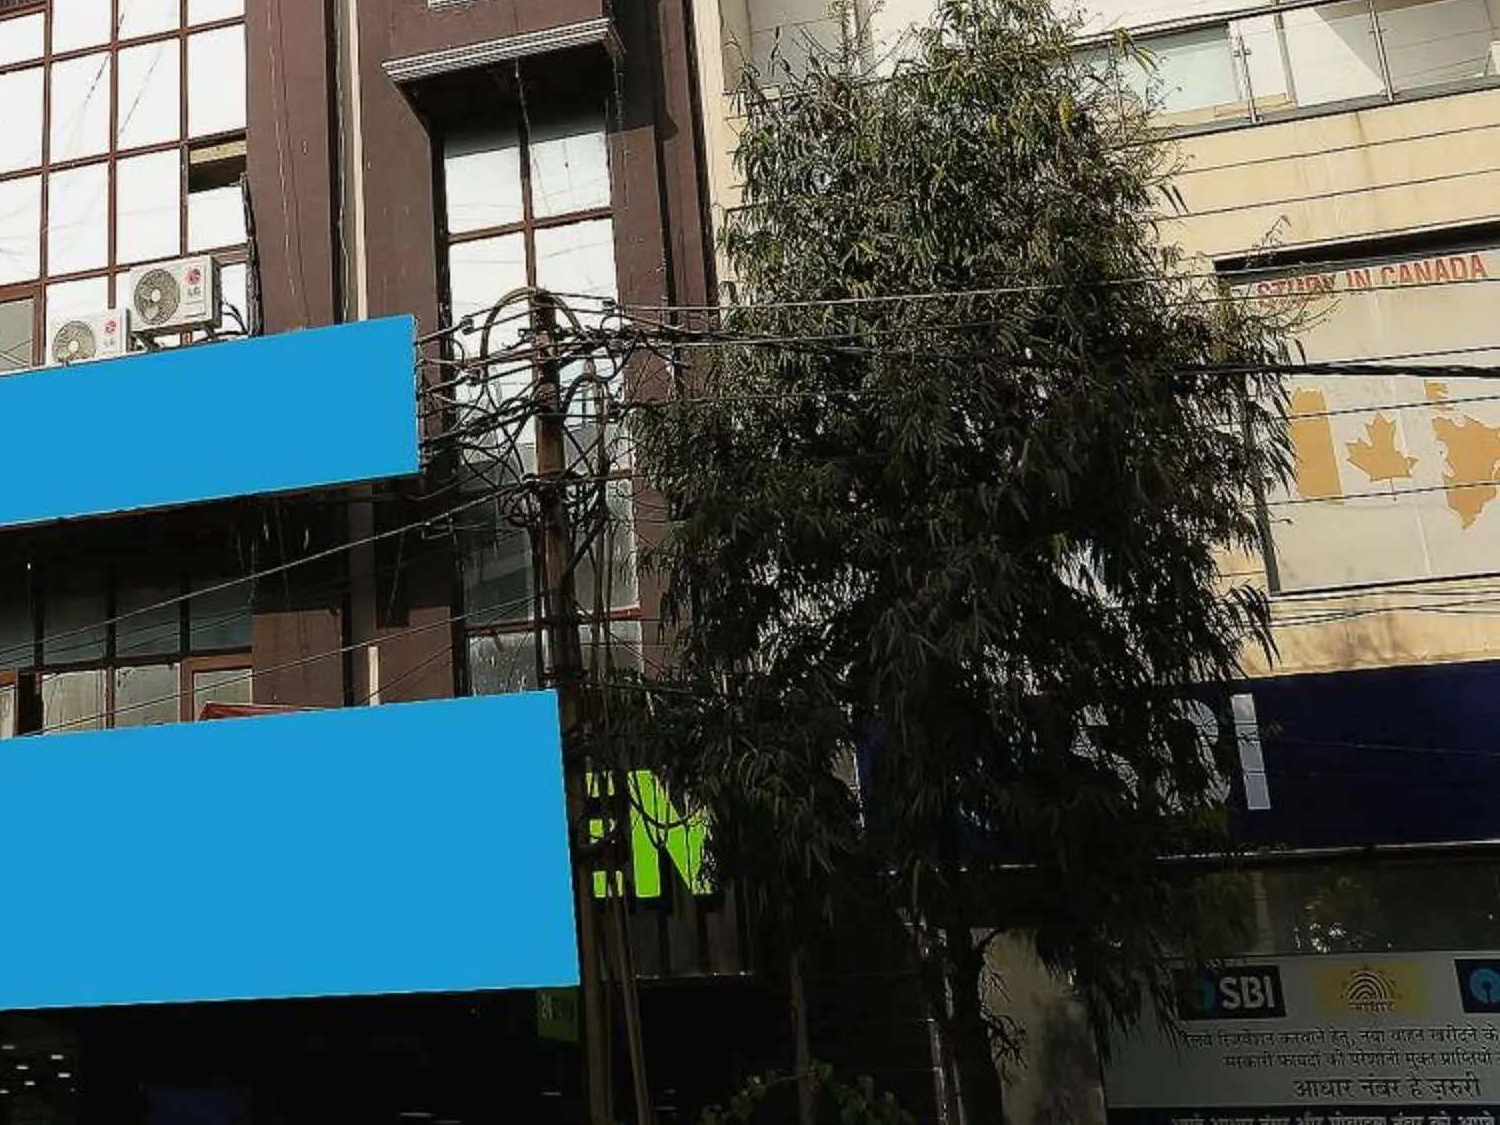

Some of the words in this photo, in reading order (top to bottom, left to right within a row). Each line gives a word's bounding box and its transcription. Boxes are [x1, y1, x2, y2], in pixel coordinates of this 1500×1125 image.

[1346, 268, 1371, 291] IN
[1380, 254, 1488, 286] CANADA
[1219, 976, 1276, 1010] SBI
[1293, 1078, 1354, 1099] आधार
[1357, 1072, 1402, 1098] नंबर
[1405, 1069, 1424, 1100] है
